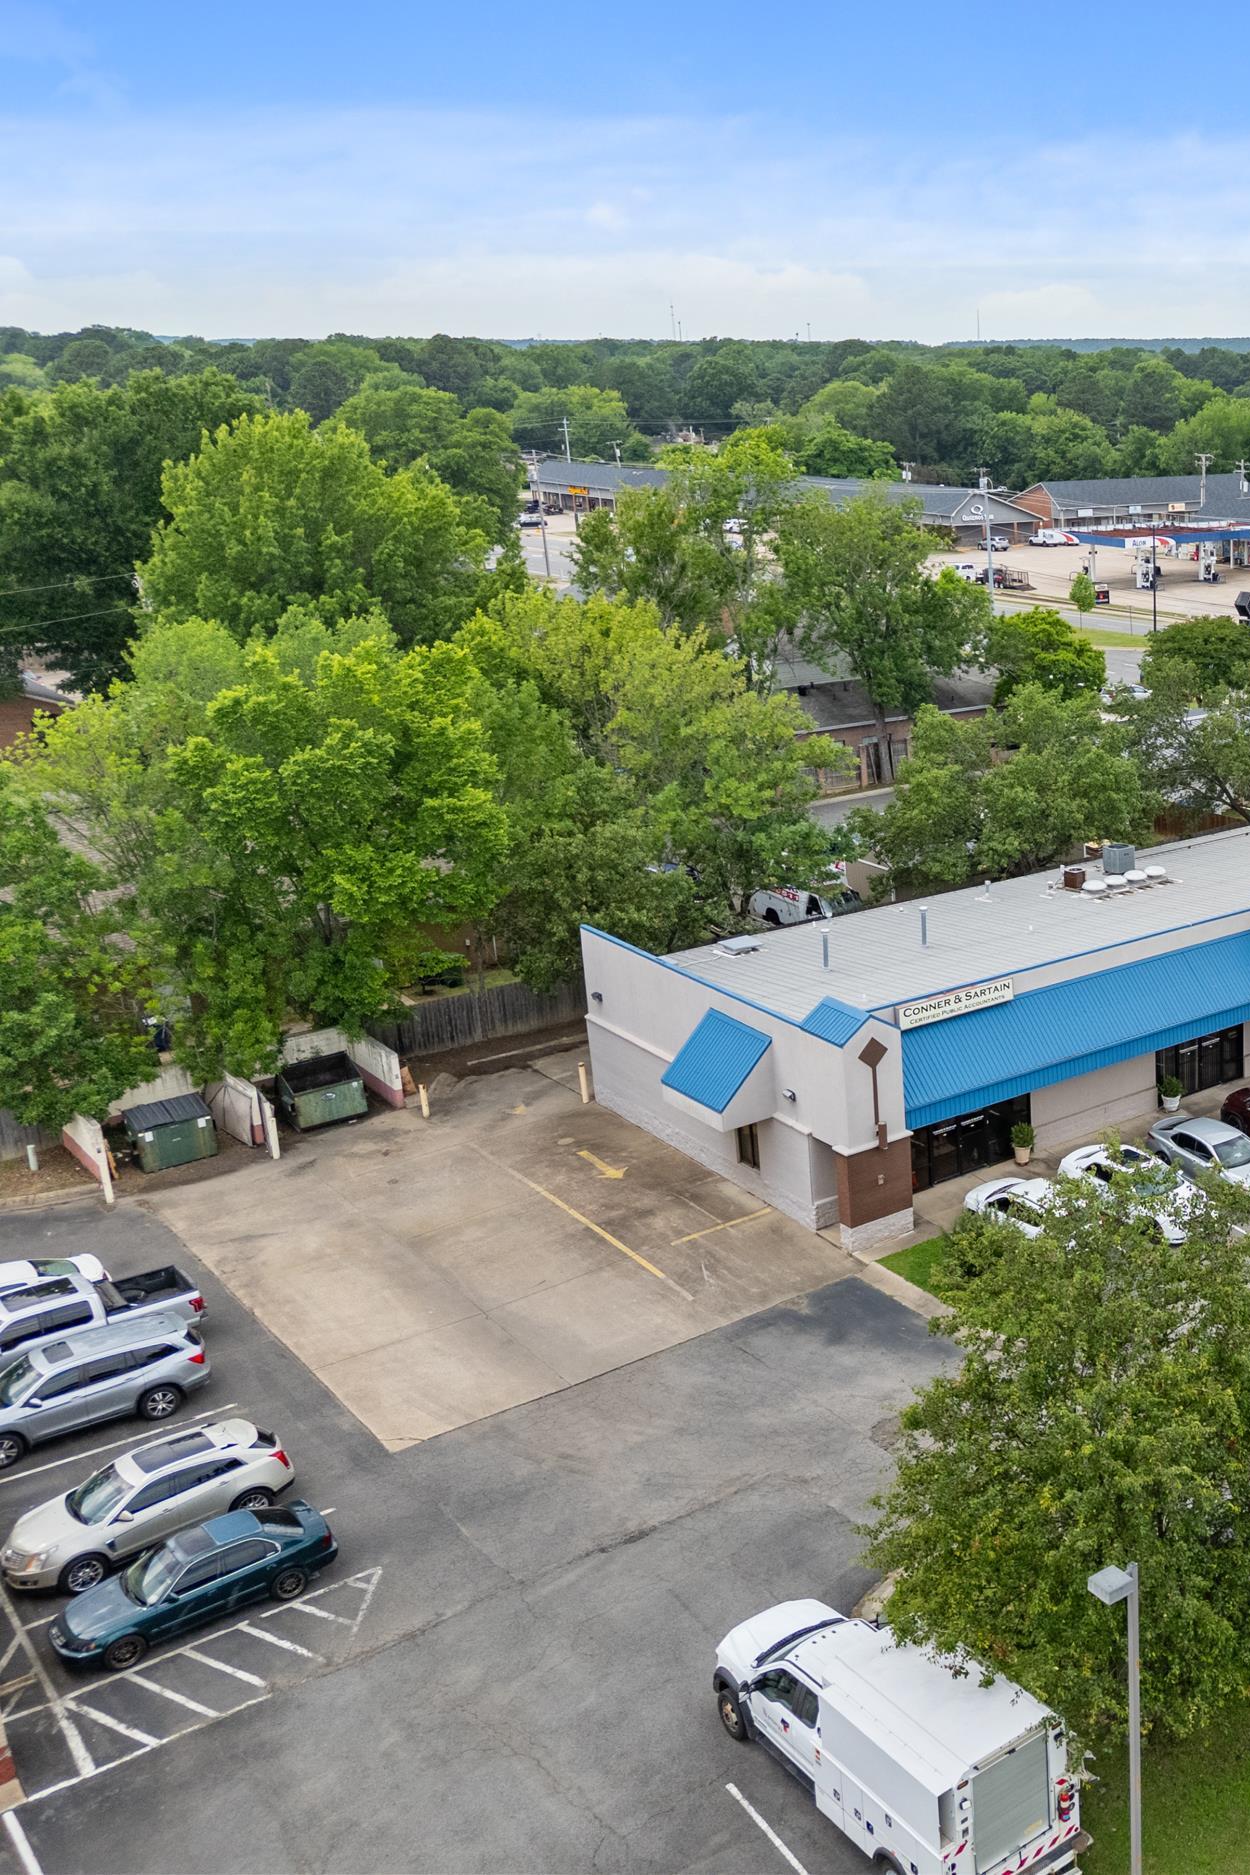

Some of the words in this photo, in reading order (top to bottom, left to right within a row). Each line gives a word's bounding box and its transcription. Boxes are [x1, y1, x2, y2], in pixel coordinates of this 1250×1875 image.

[903, 999, 951, 1018] CONNER
[953, 994, 963, 1004] &
[965, 982, 1010, 1000] SARTAIN
[909, 1012, 940, 1025] CERTIFIED
[941, 1006, 963, 1016] PUBLIC
[963, 994, 1006, 1009] ACCOUNTANTS
